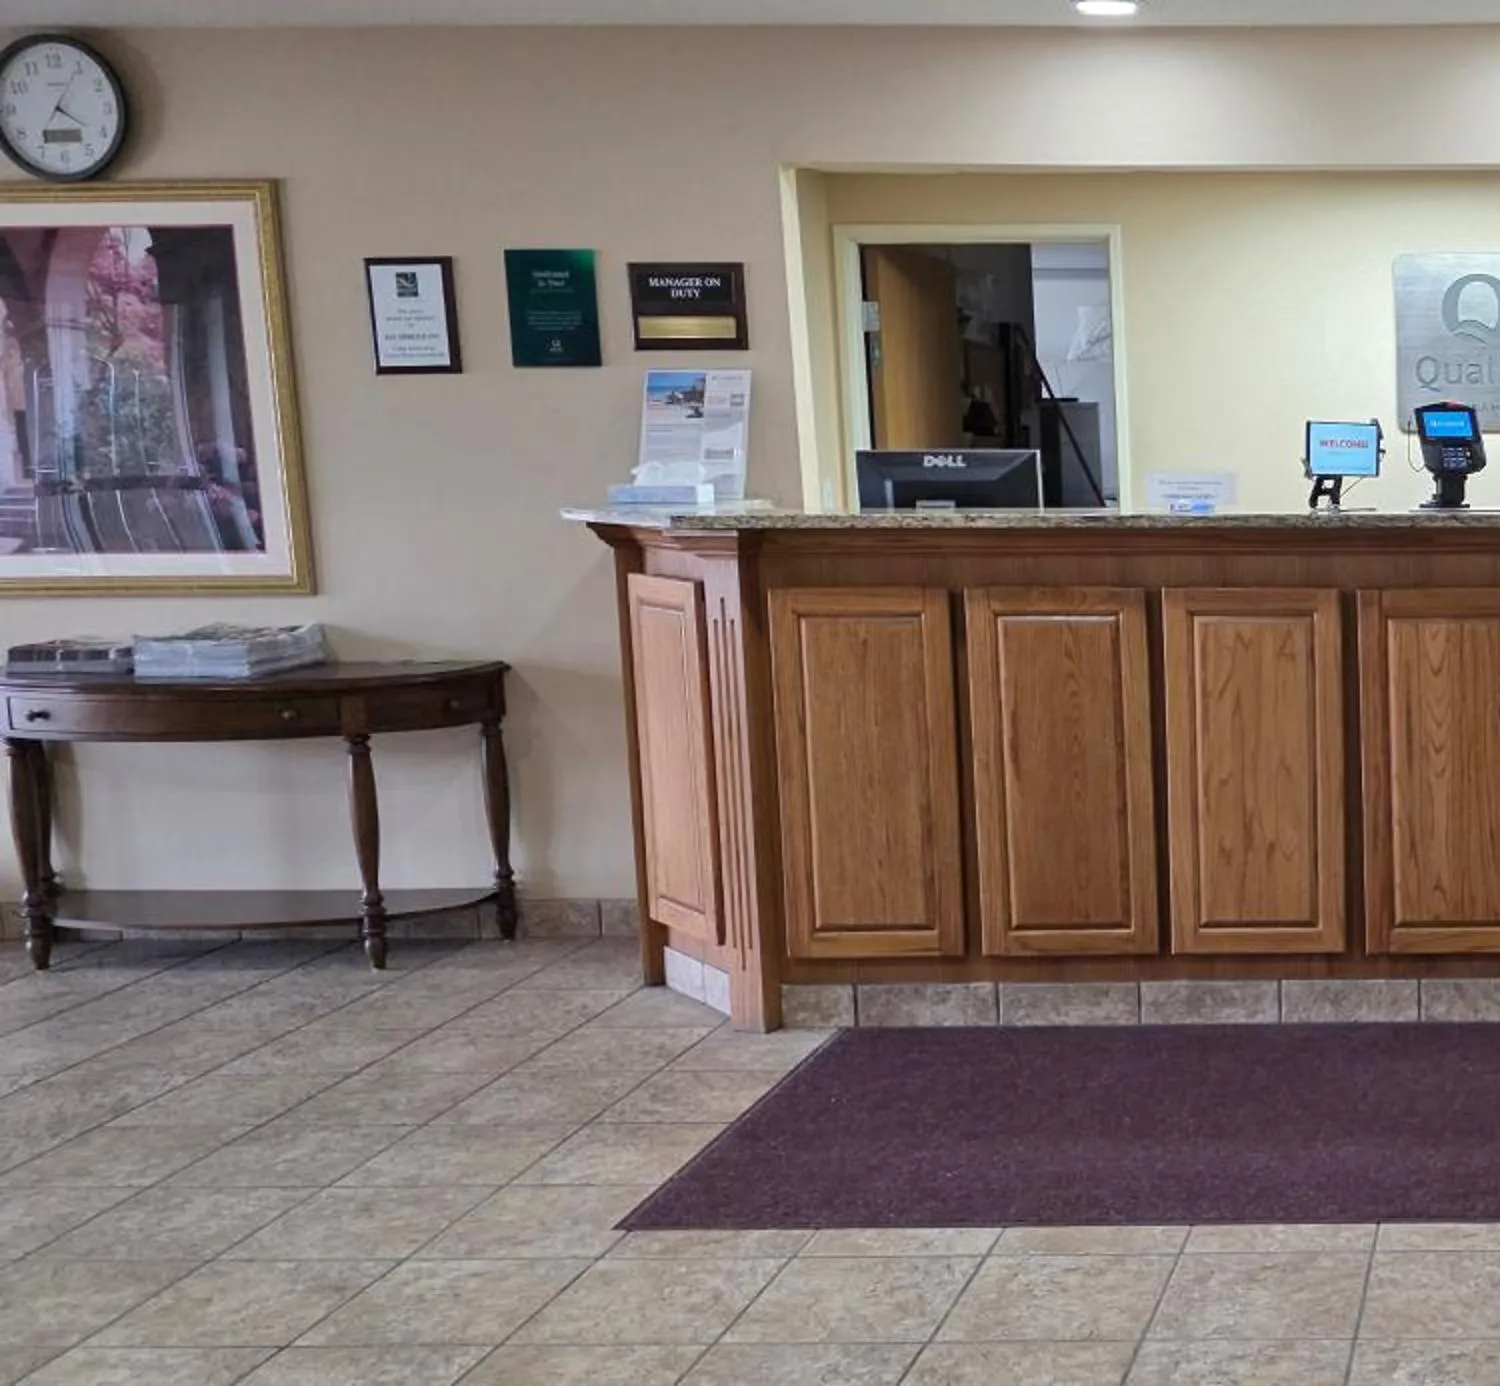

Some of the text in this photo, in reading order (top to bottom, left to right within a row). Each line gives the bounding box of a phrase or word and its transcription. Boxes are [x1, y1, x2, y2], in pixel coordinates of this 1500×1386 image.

[648, 277, 721, 287] MANAGER ON
[671, 288, 701, 299] DUTY
[923, 455, 967, 467] DELL
